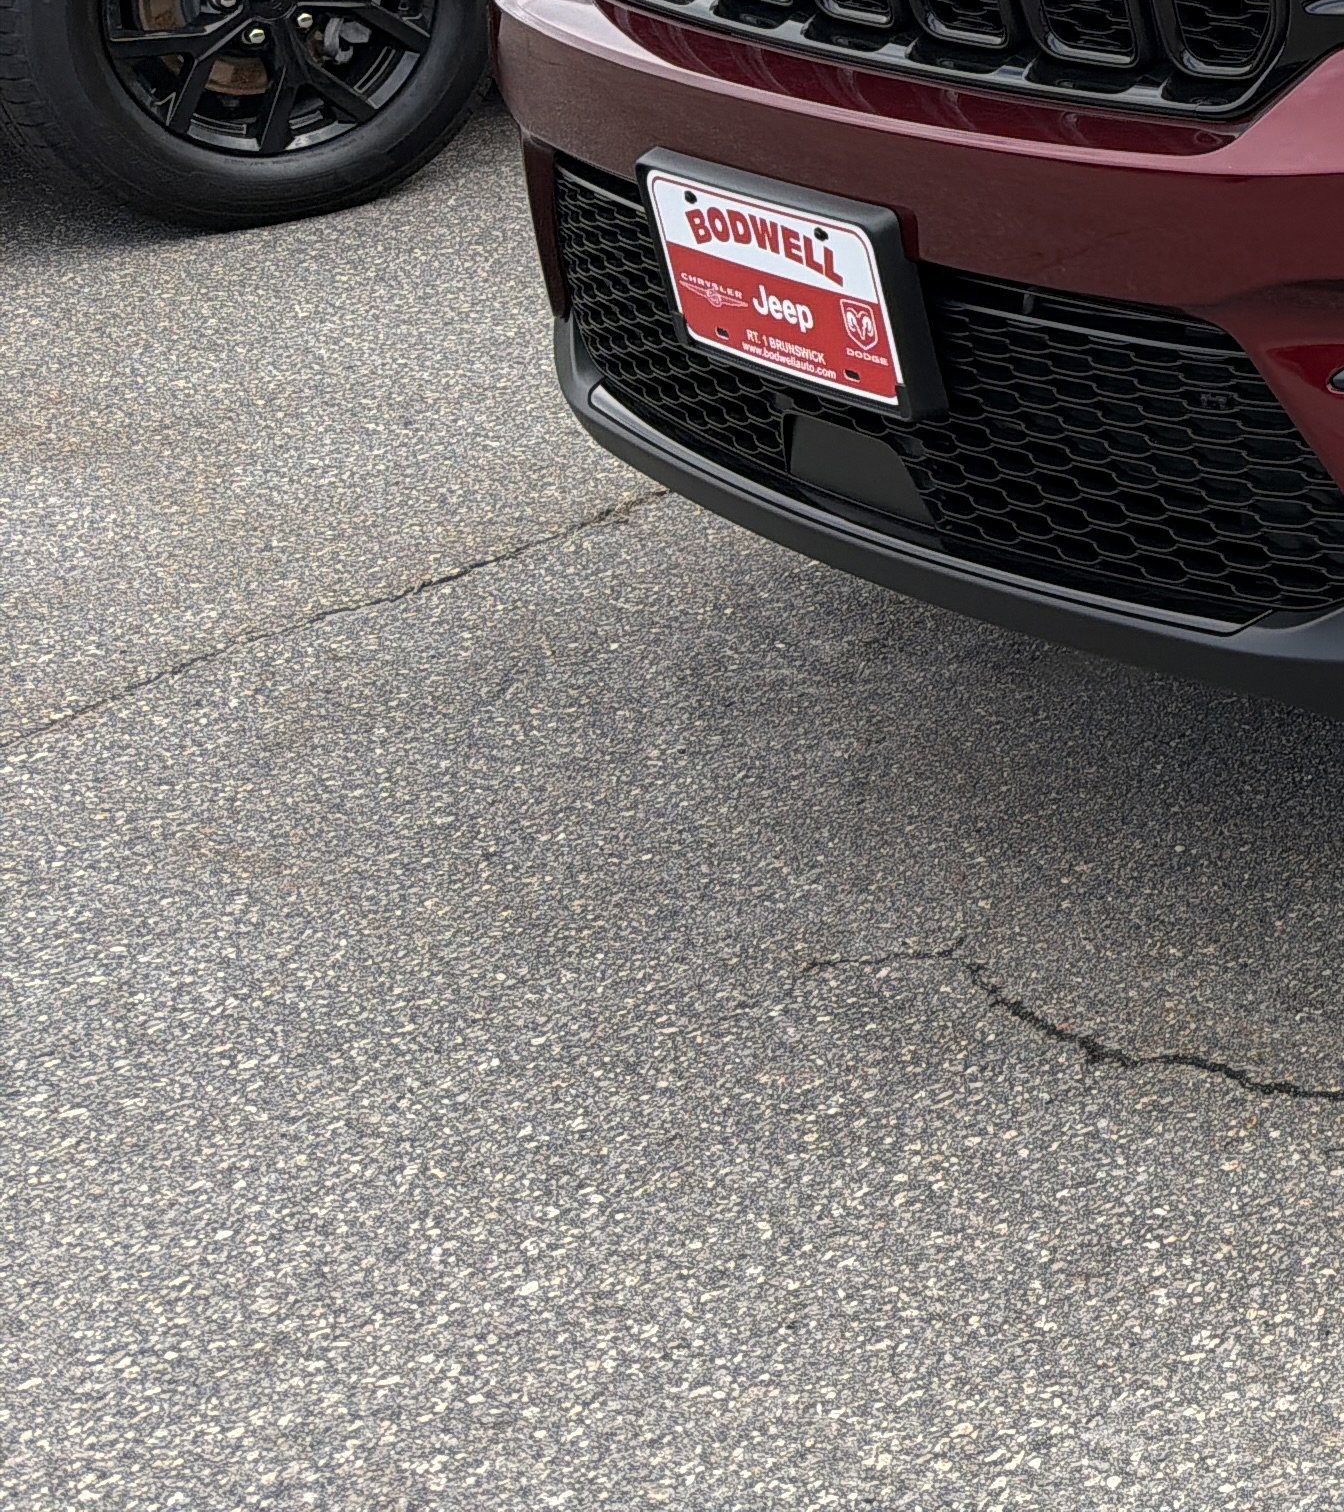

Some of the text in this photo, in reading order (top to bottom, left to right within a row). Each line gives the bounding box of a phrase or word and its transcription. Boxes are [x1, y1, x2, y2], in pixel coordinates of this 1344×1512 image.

[685, 207, 843, 287] BODWELL
[681, 272, 743, 300] CHRYSLER
[753, 285, 813, 333] Jeep
[746, 329, 761, 345] RT.
[762, 335, 768, 347] 1
[741, 342, 837, 381] www.bodwellauto.com
[846, 347, 889, 366] DODGE
